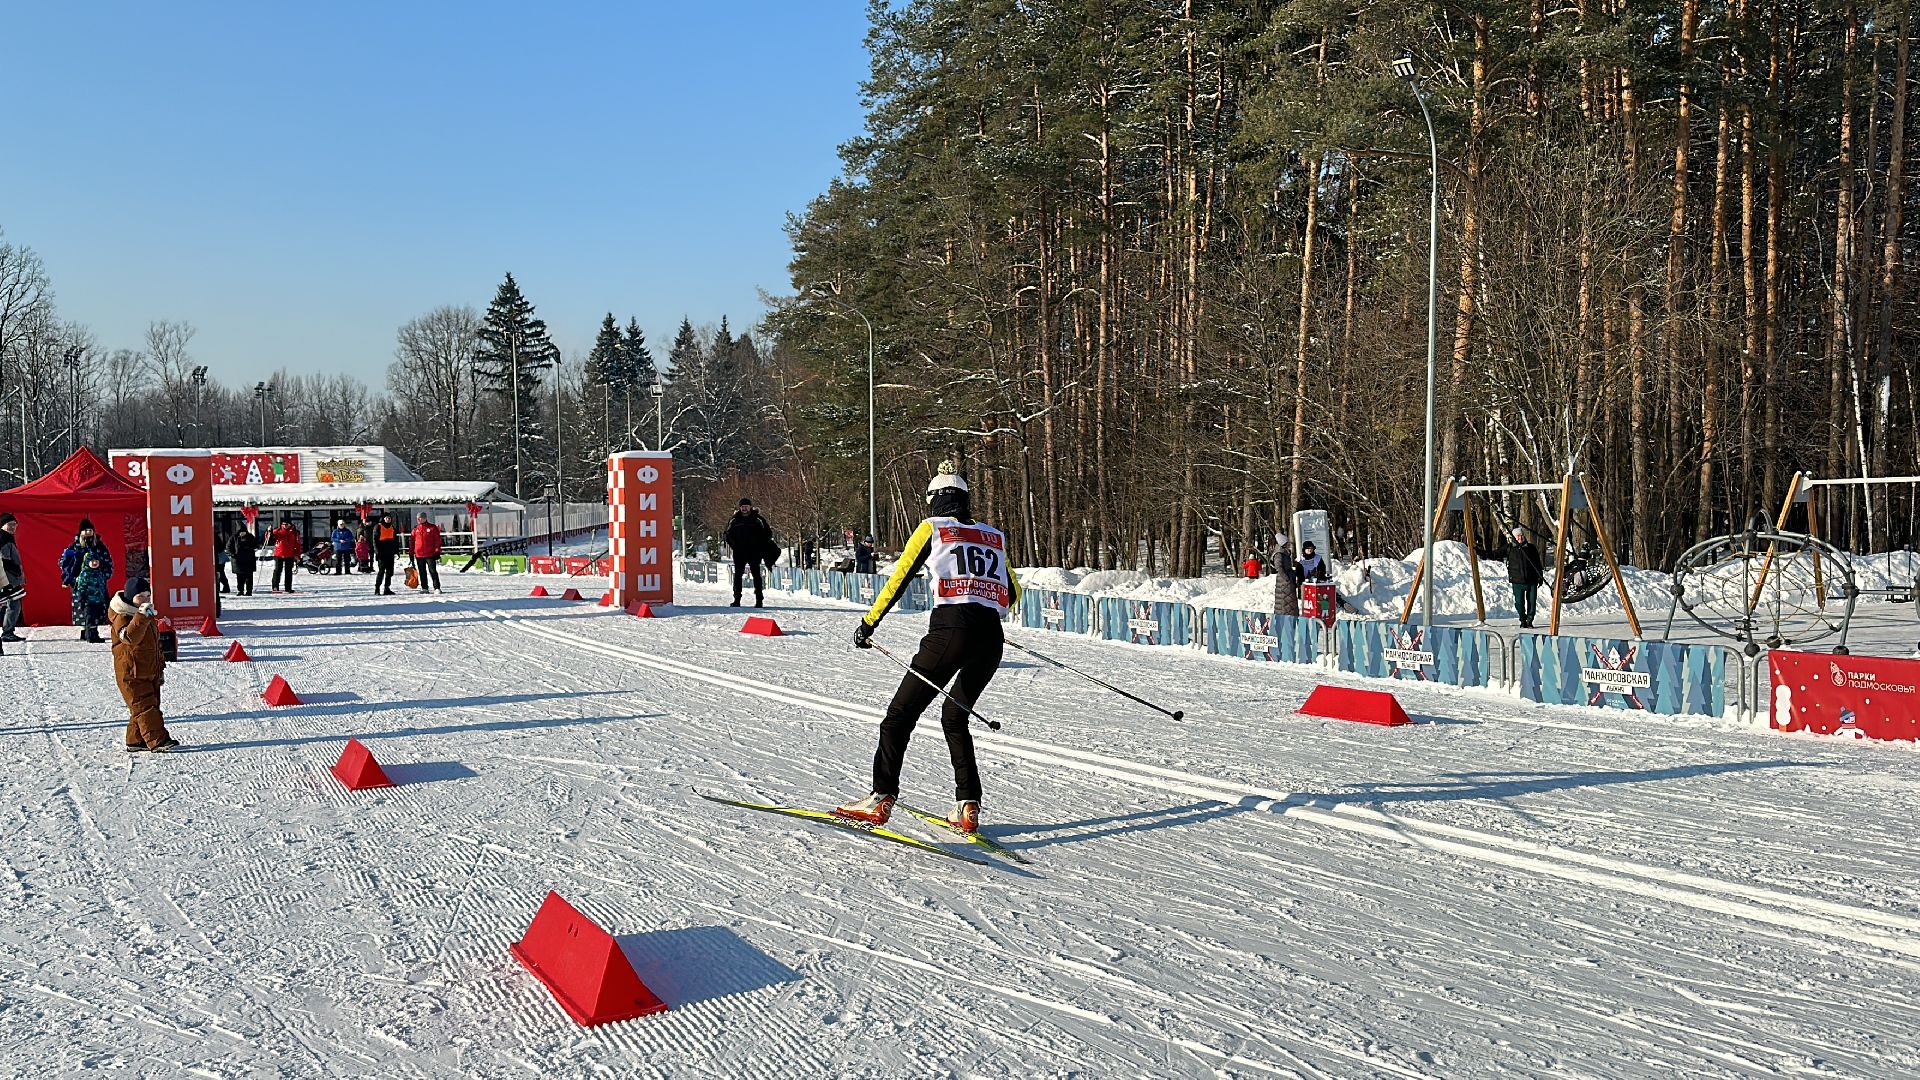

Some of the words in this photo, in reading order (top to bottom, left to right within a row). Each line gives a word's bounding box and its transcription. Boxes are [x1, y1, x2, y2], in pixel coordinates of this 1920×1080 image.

[166, 464, 199, 607] ФИНИШ
[637, 465, 660, 592] ФИНИШ
[950, 545, 1001, 580] 162
[943, 579, 973, 589] ЦЕНТР
[973, 580, 997, 592] ВФСК
[1584, 669, 1648, 685] МАНЖОСОВСКАЯ
[1847, 671, 1876, 681] ПАРКИ
[1848, 679, 1916, 693] ПОДМОСКОВЬЯ
